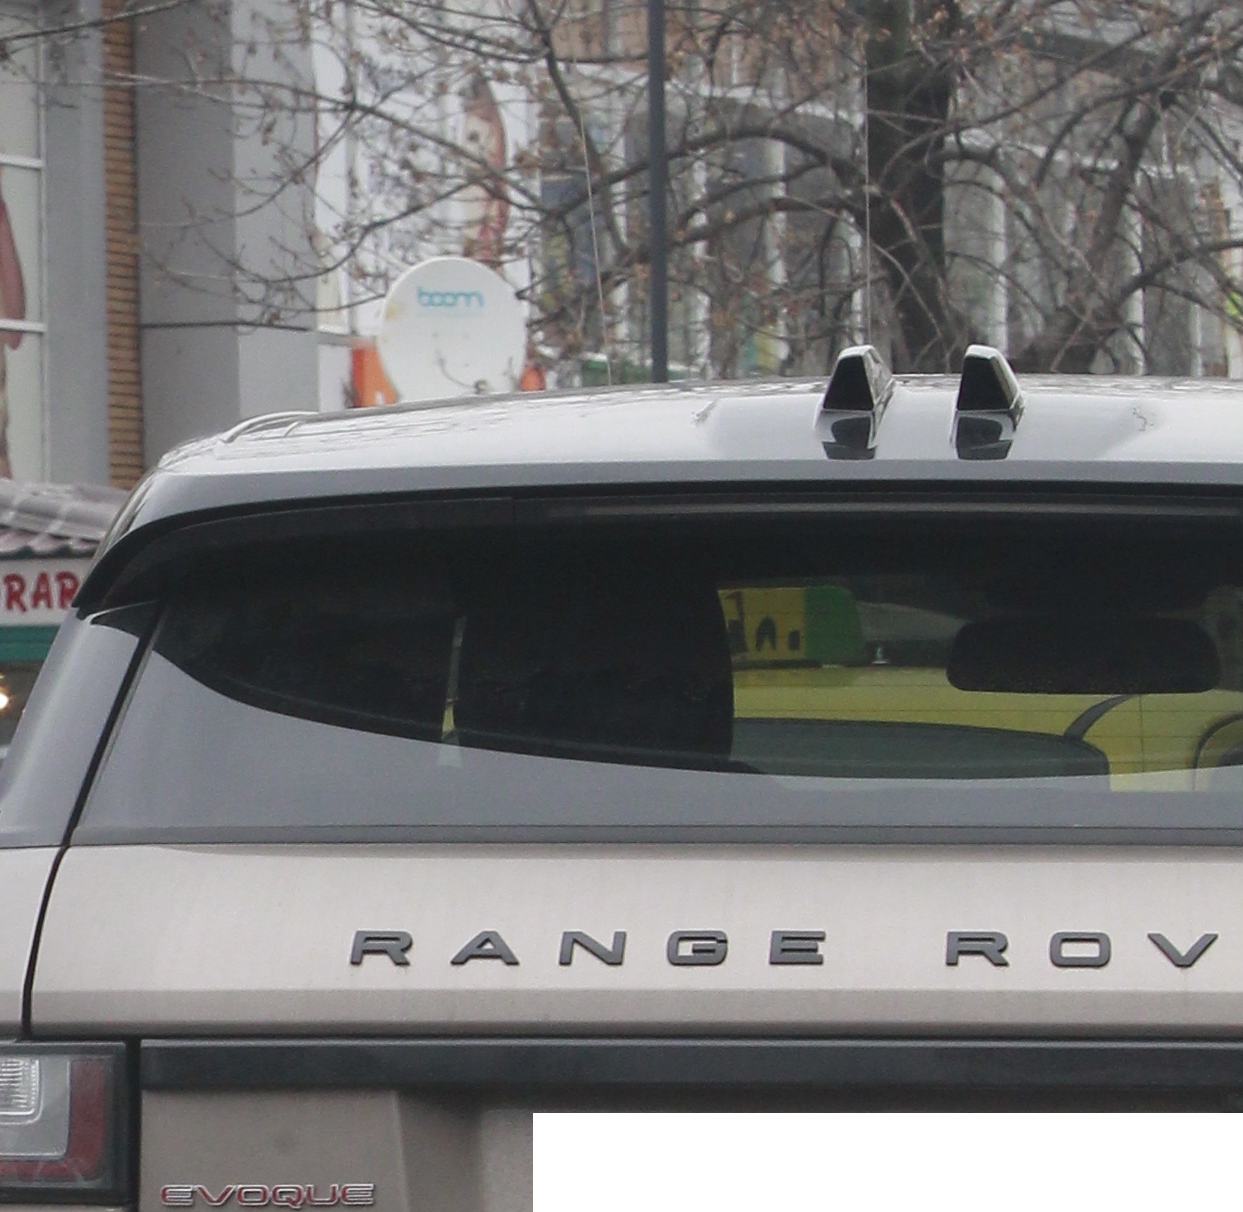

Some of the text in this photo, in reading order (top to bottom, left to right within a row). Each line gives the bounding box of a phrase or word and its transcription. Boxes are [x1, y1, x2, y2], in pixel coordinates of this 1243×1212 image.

[349, 929, 1219, 968] RANGE ROV
[160, 1183, 375, 1210] EVOQUE
